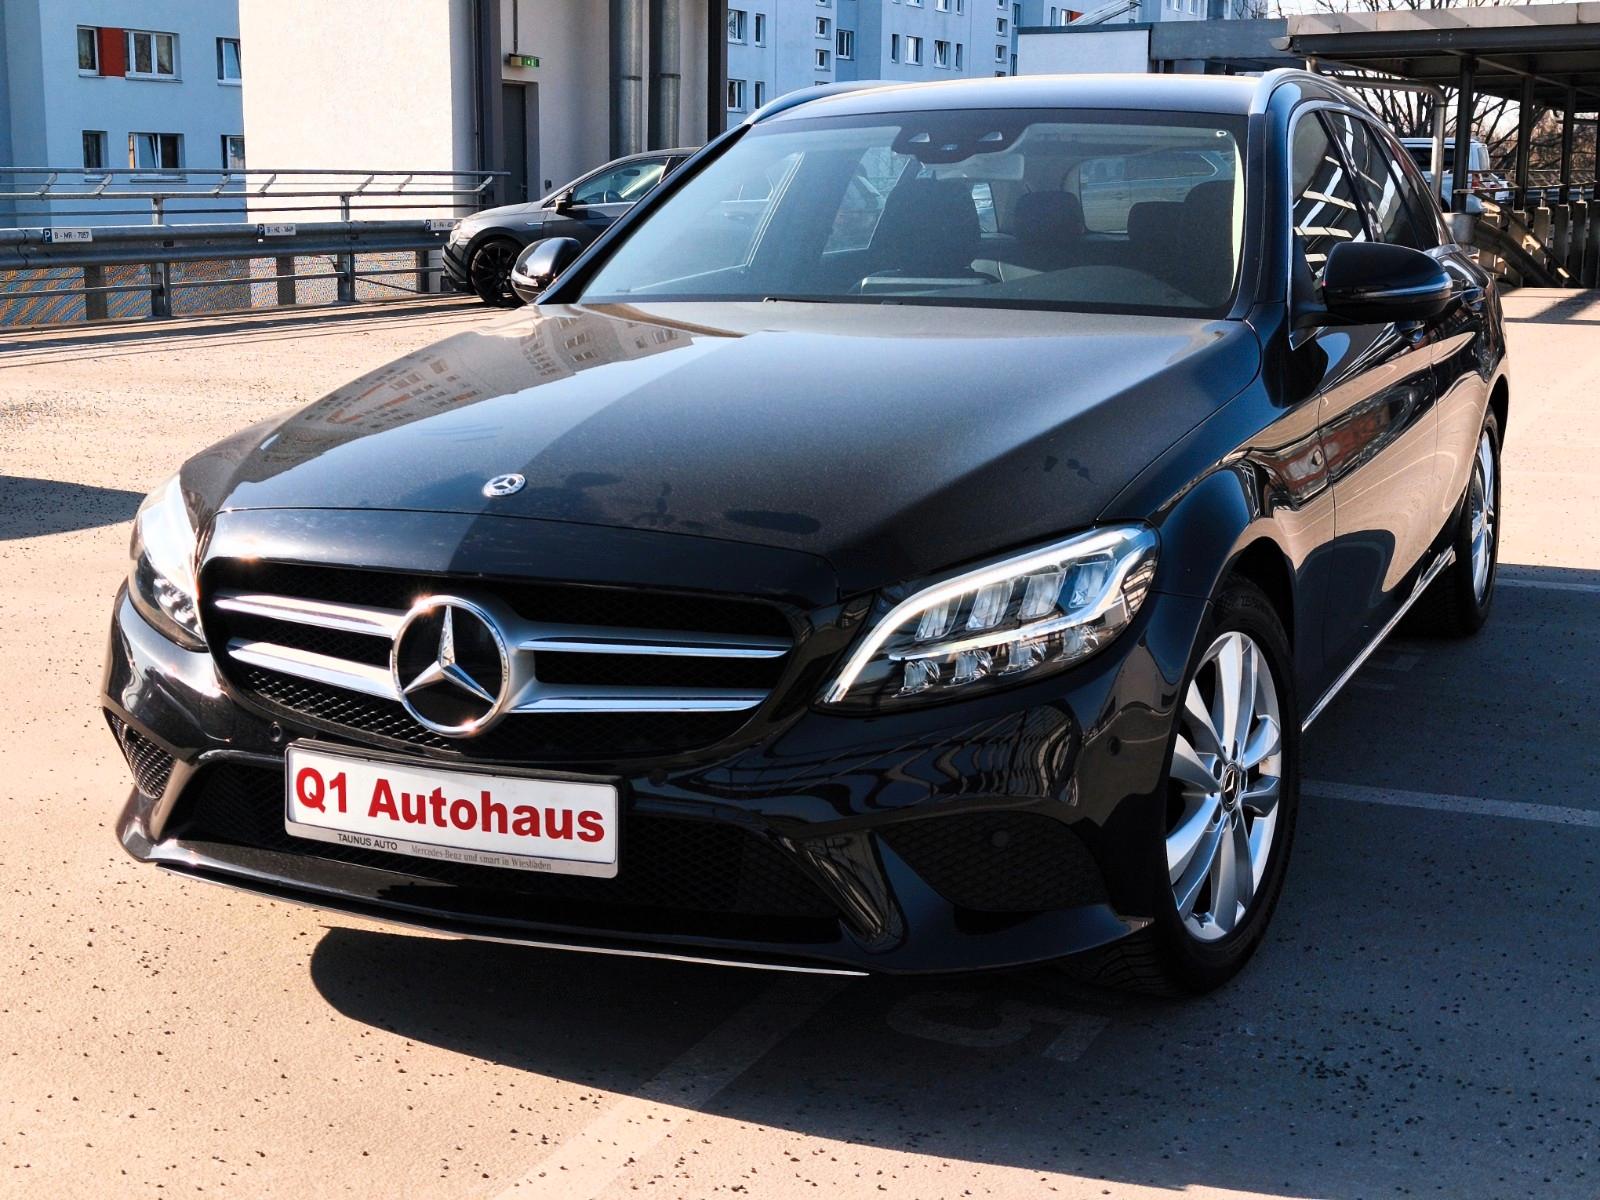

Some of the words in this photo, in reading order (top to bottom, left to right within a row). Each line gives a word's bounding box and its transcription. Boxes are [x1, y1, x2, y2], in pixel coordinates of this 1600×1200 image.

[295, 767, 347, 814] Q1
[367, 778, 606, 843] Autohaus
[337, 833, 372, 847] TAUNUS
[373, 839, 398, 851] AUTO
[463, 853, 478, 862] und
[480, 856, 499, 865] smart
[511, 857, 552, 871] Wiesbaden
